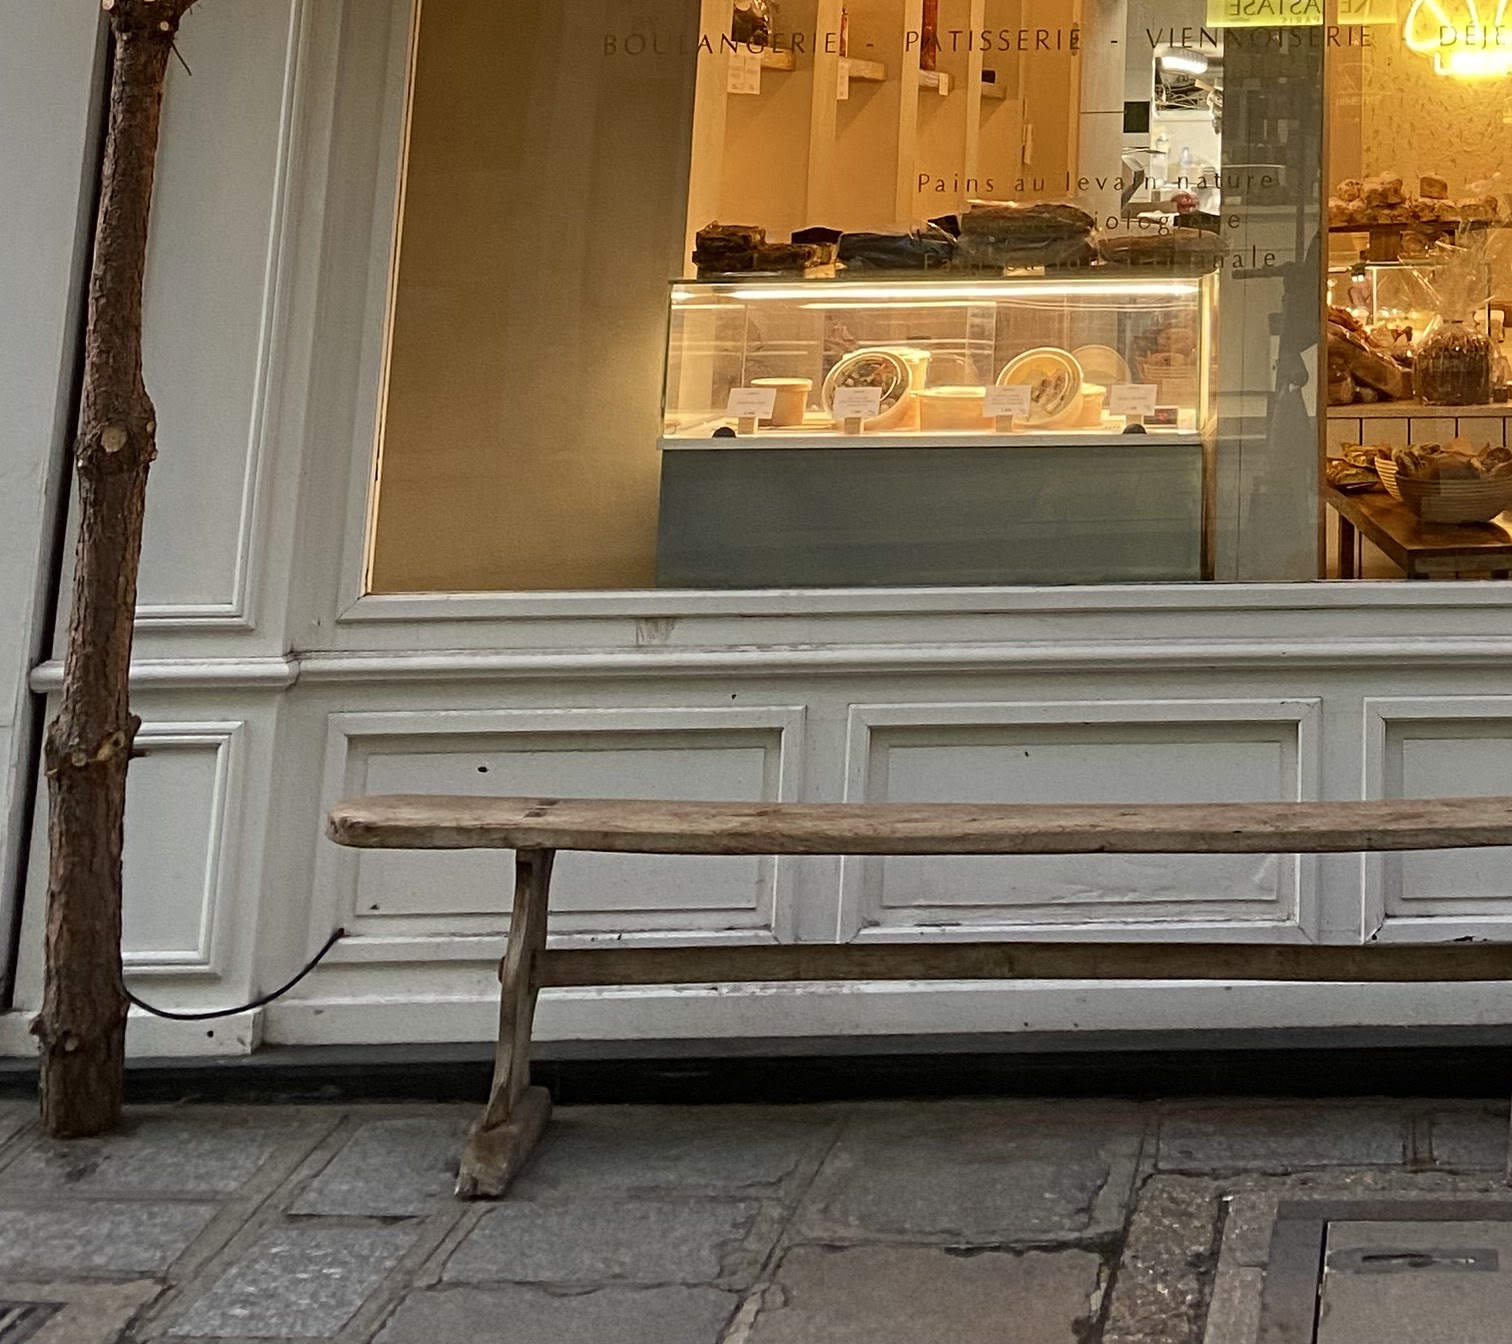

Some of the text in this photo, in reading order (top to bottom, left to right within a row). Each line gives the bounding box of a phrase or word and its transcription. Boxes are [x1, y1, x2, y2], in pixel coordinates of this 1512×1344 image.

[604, 32, 837, 55] BOULANGERIE
[1146, 26, 1372, 49] VIENNOISERIE
[918, 173, 994, 193] Pains
[1014, 177, 1046, 192] au
